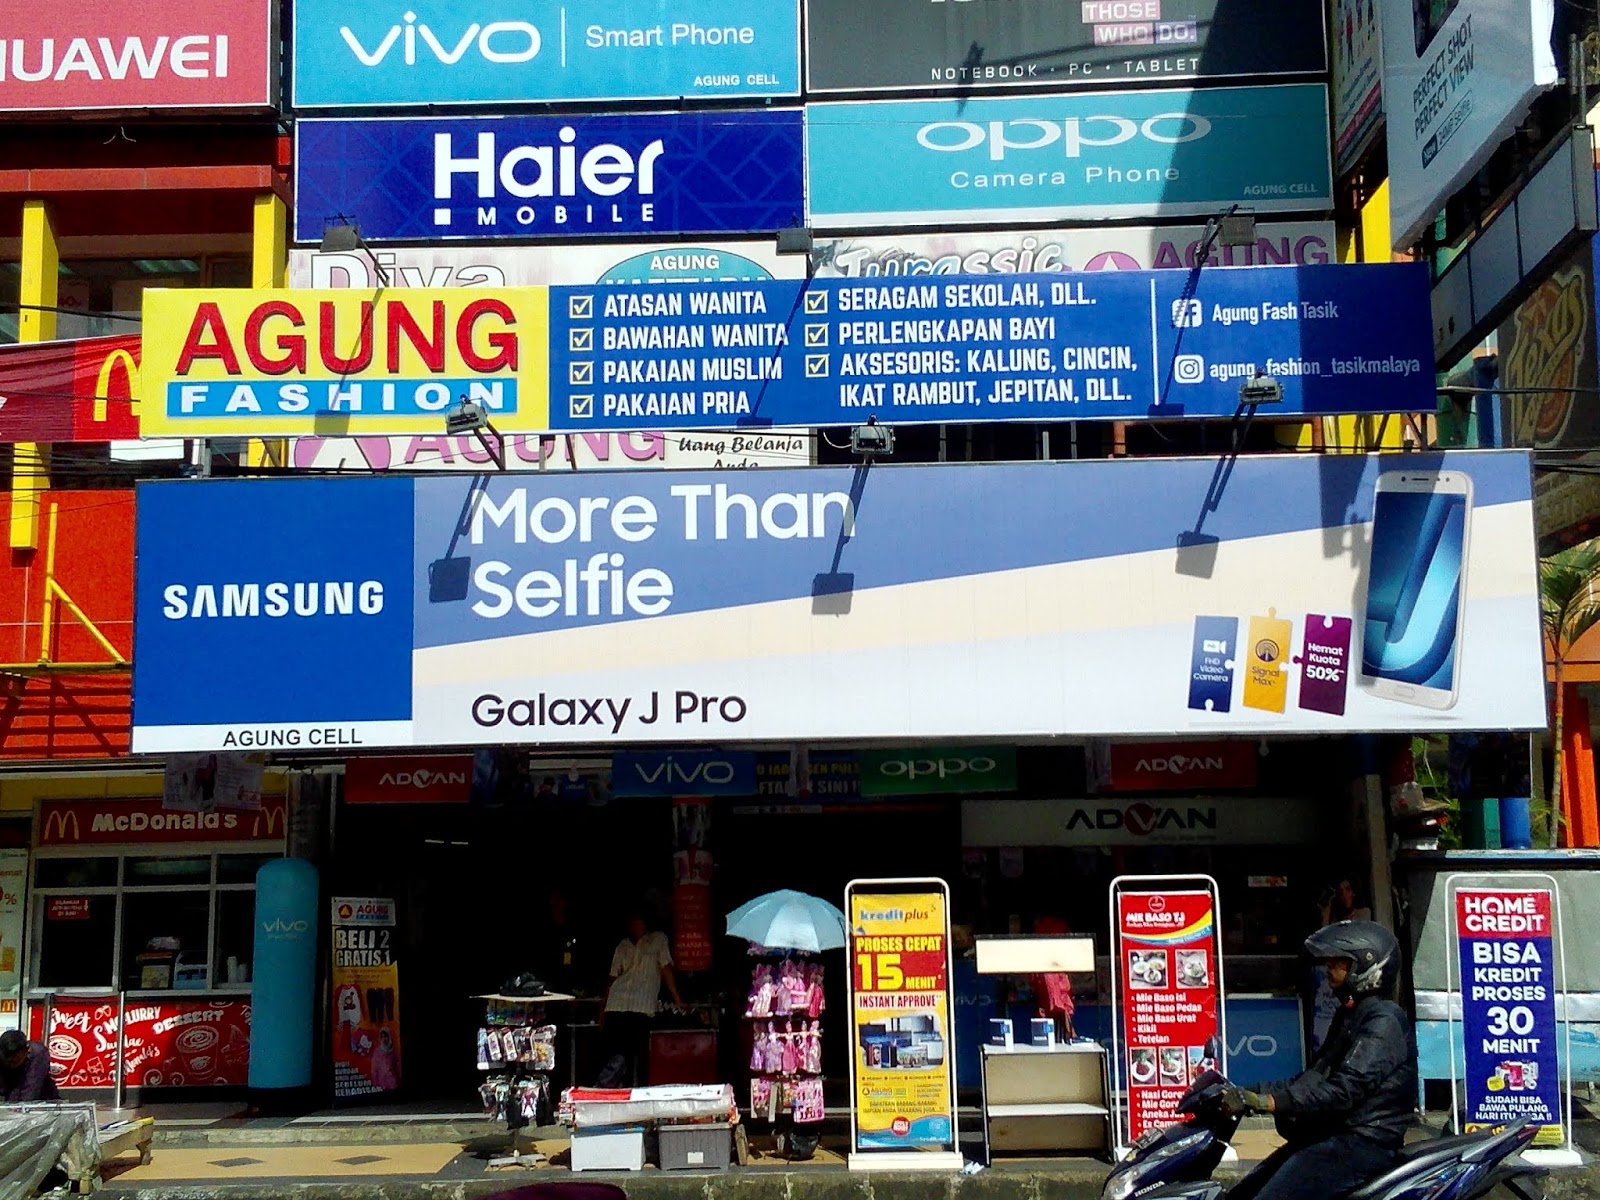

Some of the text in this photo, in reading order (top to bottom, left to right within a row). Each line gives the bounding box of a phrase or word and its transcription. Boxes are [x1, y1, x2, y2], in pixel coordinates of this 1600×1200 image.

[1085, 3, 1157, 21] THOSE
[340, 10, 541, 67] vivo
[586, 23, 755, 48] Smart Phone
[1099, 25, 1150, 44] WHO
[0, 35, 228, 82] UAWEI
[1413, 50, 1446, 112] PERFECT
[1447, 13, 1472, 65] SHOT
[931, 58, 1199, 80] NOTEBOOK PC TABLET
[694, 74, 779, 86] AGUNG CELL
[1415, 79, 1448, 140] PERFECT
[1448, 45, 1474, 92] VIEW
[916, 112, 1212, 161] oppo
[434, 126, 664, 199] Haier
[951, 166, 1180, 189] Camera Phone
[1244, 182, 1317, 196] AGUNG CELL
[478, 203, 655, 226] MOBILE
[650, 255, 720, 270] AGUNG
[604, 291, 767, 318] ATASAN WANITA
[838, 283, 1096, 312] SERAGAM SEKOLAH, DLL.
[1212, 301, 1339, 326] Agung Fash Tasik
[175, 300, 518, 375] AGUNG
[604, 323, 789, 350] BAWAHAN WANITA
[839, 317, 1055, 345] PERLENGKAPAN BAYI
[604, 357, 782, 383] PAKAIAN MUSLIM
[840, 347, 1138, 376] AKSESORIS: KALUNG, CINCIN,
[181, 382, 504, 413] FASHION
[840, 377, 1132, 407] IKAT RAMBUT, JEPITAN, DLL.
[604, 391, 750, 416] PAKAIAN PRIA
[679, 435, 803, 455] Uang Belanja
[471, 483, 856, 544] More Than
[471, 552, 674, 620] Selfie
[163, 580, 384, 620] SAMSUNG
[1308, 643, 1343, 656] Hemat
[1308, 653, 1341, 666] Kuota
[1193, 673, 1229, 683] Camera
[1199, 665, 1224, 675] Video
[1252, 666, 1280, 678] Signal
[471, 691, 747, 735] Galaxy J Pro
[223, 728, 363, 748] AGUNG CELL
[635, 756, 734, 784] vivo
[880, 757, 996, 780] oppo
[1135, 755, 1223, 774] ADVAN
[379, 769, 465, 789] ADVAN
[92, 811, 237, 833] McDonald's
[1066, 803, 1217, 836] ADVAN
[0, 869, 23, 877] emat
[357, 905, 388, 914] AGUNG
[1465, 896, 1536, 914] HOME
[262, 916, 309, 932] vivo
[1465, 915, 1544, 932] CREDIT
[336, 930, 390, 949] BELI 2
[856, 936, 941, 952] PROSES CEPAT
[336, 950, 390, 967] GRATIS 1
[1472, 942, 1541, 964] BISA
[857, 954, 903, 990] 15
[1474, 968, 1541, 982] KREDIT
[859, 995, 895, 1008] INSTANT
[1136, 993, 1153, 1002] Mie
[1153, 993, 1175, 1002] Baso
[1472, 986, 1546, 1001] PROSES
[1137, 1003, 1202, 1013] Mie Baso Pedas
[1137, 1014, 1196, 1023] Mie Baso Urat
[1487, 1006, 1534, 1035] 30
[1138, 1024, 1157, 1033] Kikil
[1138, 1035, 1169, 1044] Tetelan
[1483, 1039, 1540, 1054] MENIT
[1141, 1090, 1160, 1099] Nasi
[1485, 1096, 1543, 1104] SUDAH BISA
[1141, 1100, 1159, 1109] Mie
[1142, 1110, 1169, 1118] Aneka
[1479, 1104, 1549, 1112] BAWA PULANG
[1475, 1112, 1499, 1120] HARI
[1500, 1112, 1516, 1120] ITU
[1134, 1181, 1165, 1198] HONDA
